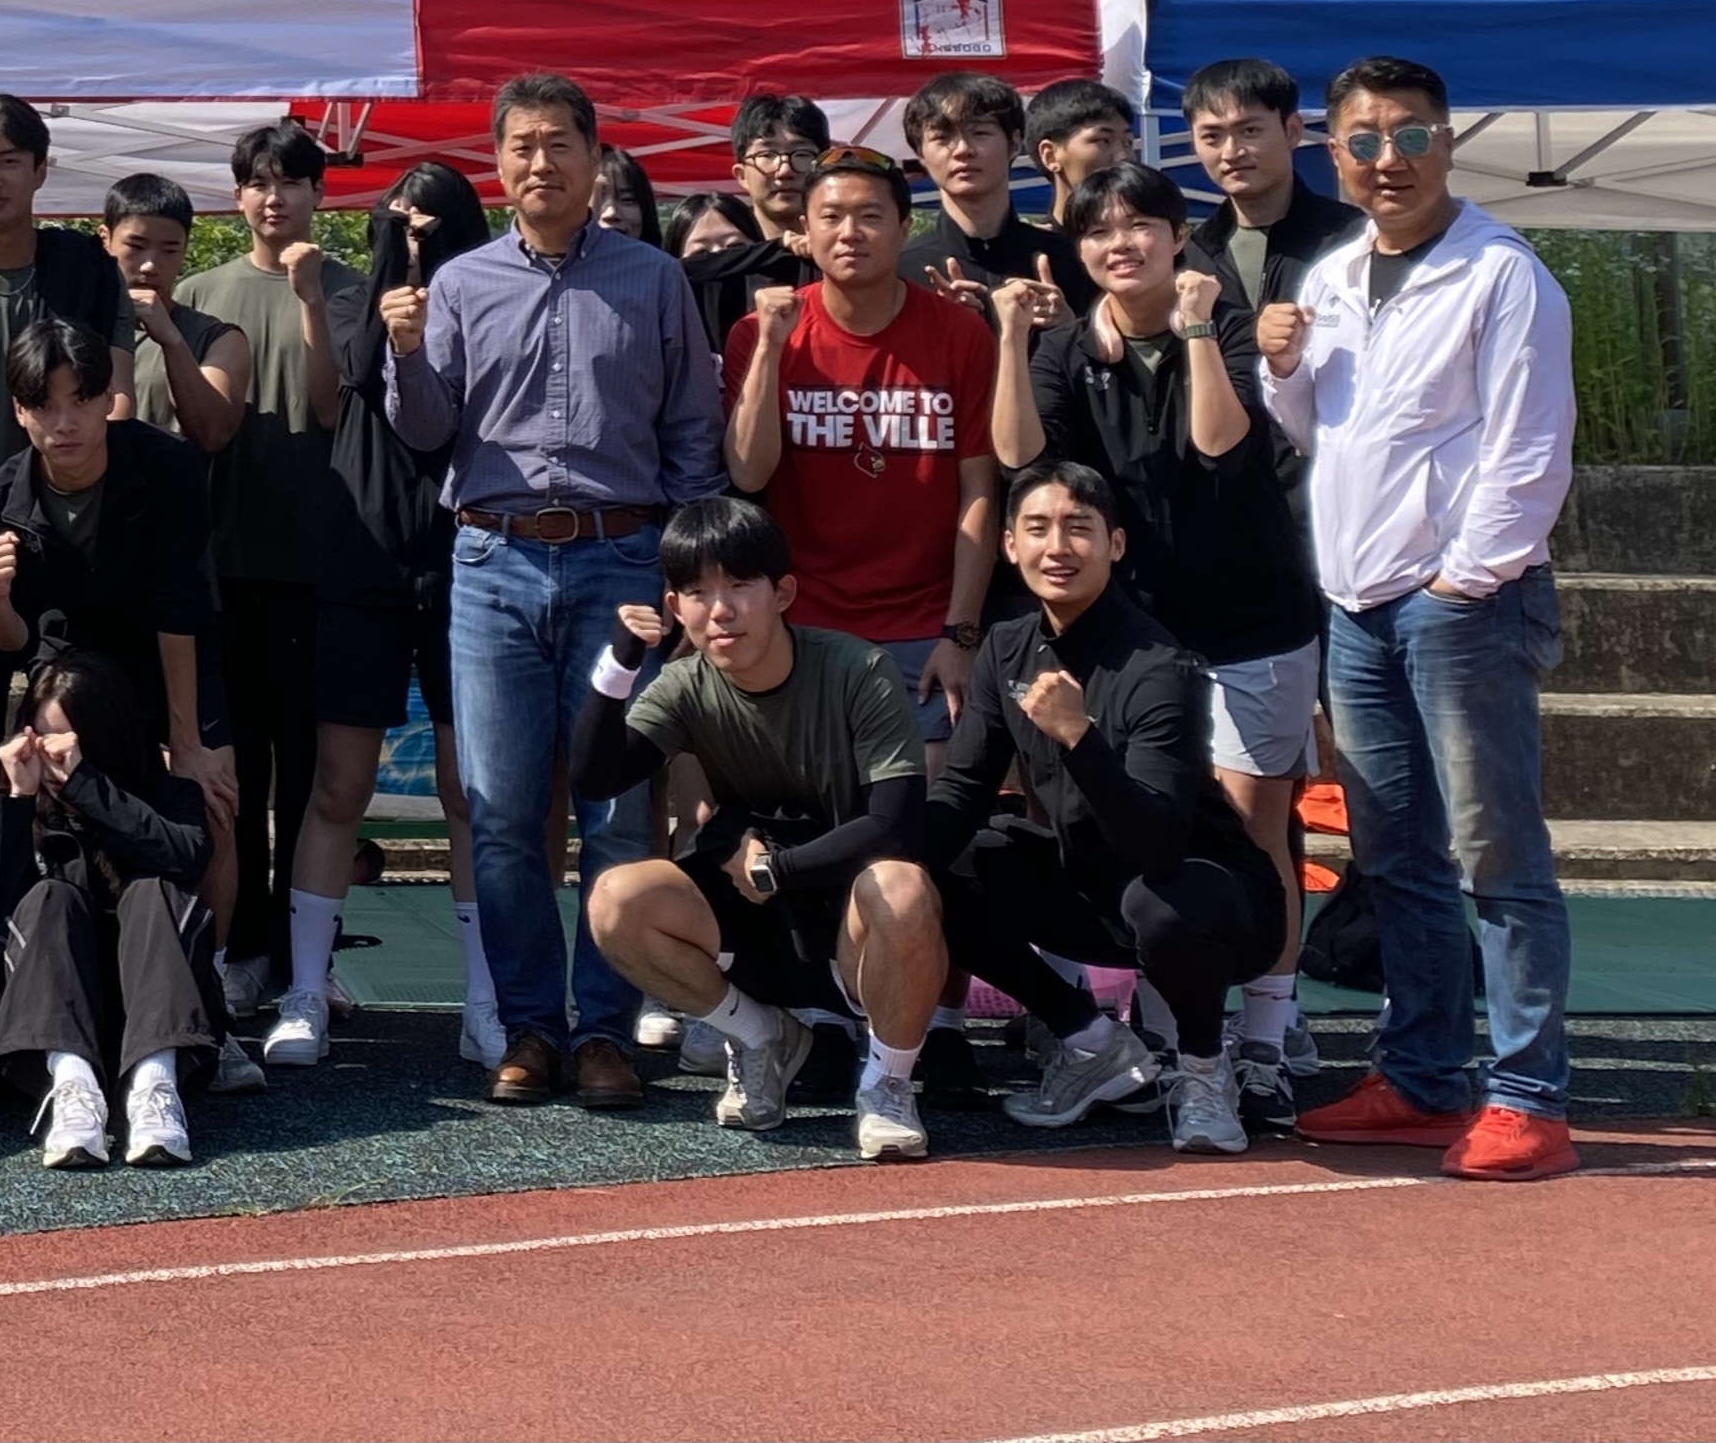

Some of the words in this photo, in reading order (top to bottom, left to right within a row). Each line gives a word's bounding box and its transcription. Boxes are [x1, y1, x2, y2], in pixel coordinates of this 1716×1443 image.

[787, 390, 916, 414] WELCOME
[919, 390, 954, 415] TO
[786, 412, 854, 447] THE
[862, 414, 955, 449] VILLE
